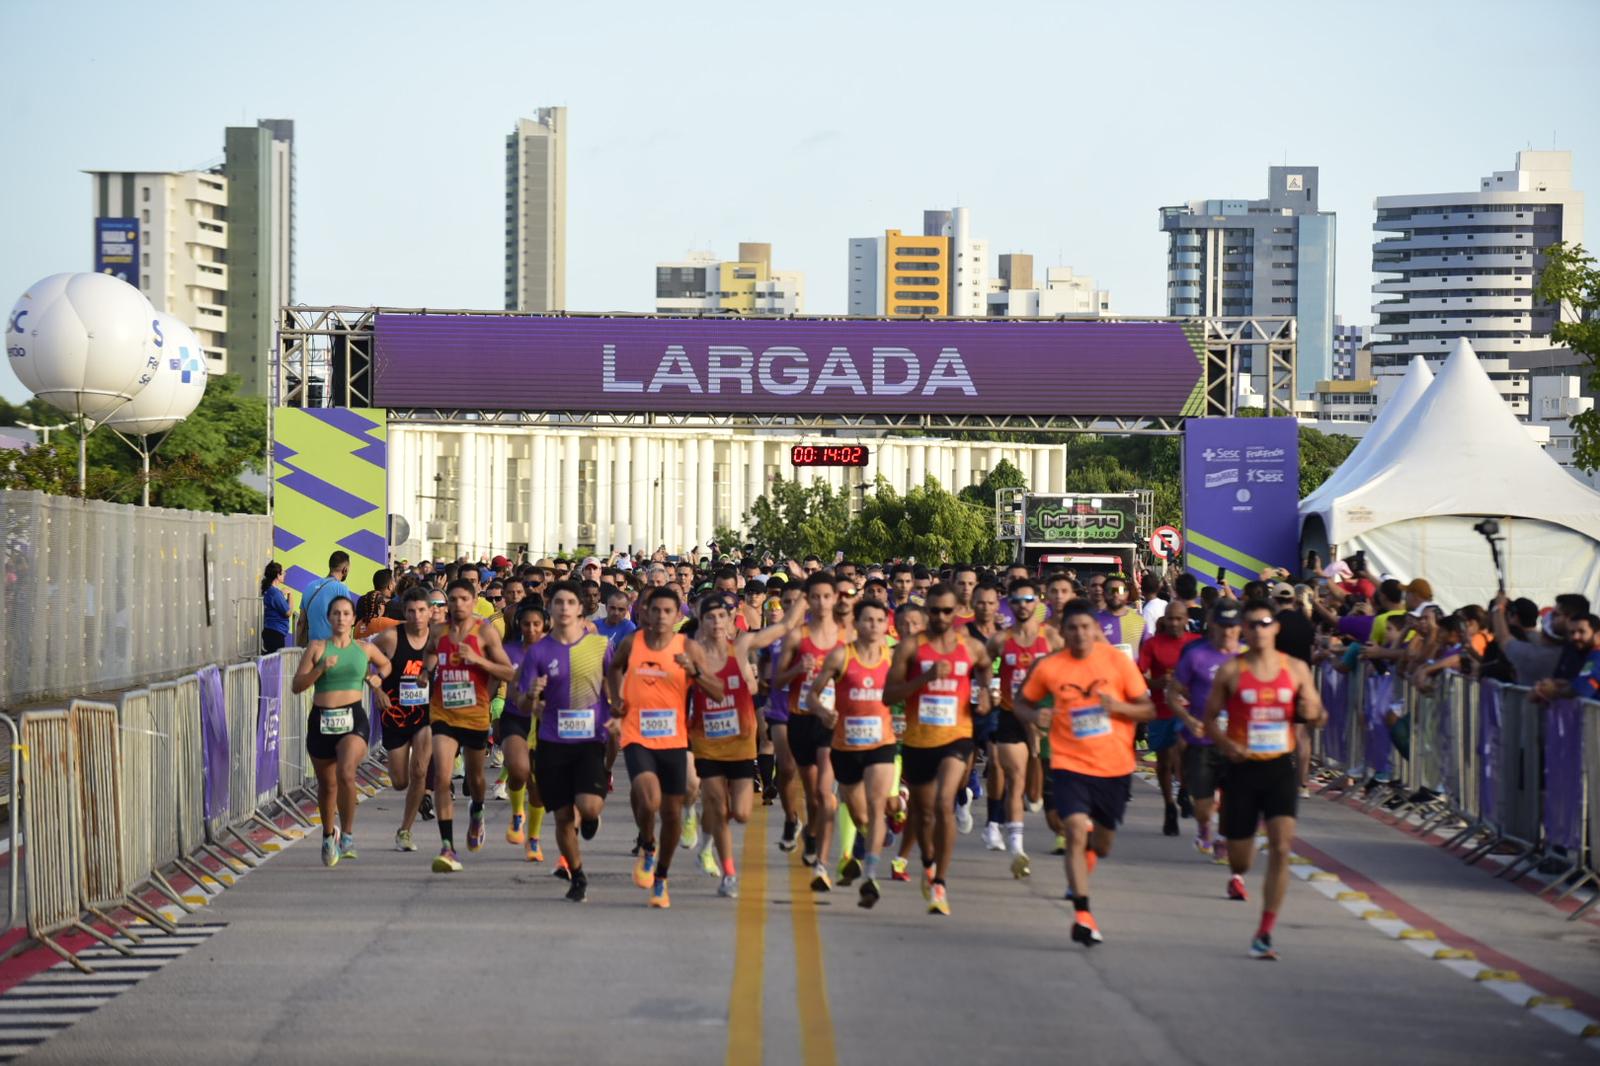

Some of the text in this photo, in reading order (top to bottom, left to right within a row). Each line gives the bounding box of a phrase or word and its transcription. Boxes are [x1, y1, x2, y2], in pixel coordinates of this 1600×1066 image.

[602, 344, 978, 396] LARGADA
[793, 447, 862, 463] 00:14:02
[1217, 447, 1241, 458] Sesc
[1257, 469, 1284, 482] Sesc
[1043, 513, 1120, 529] IMPACTO
[446, 690, 468, 701] 6417
[325, 717, 346, 727] 7370
